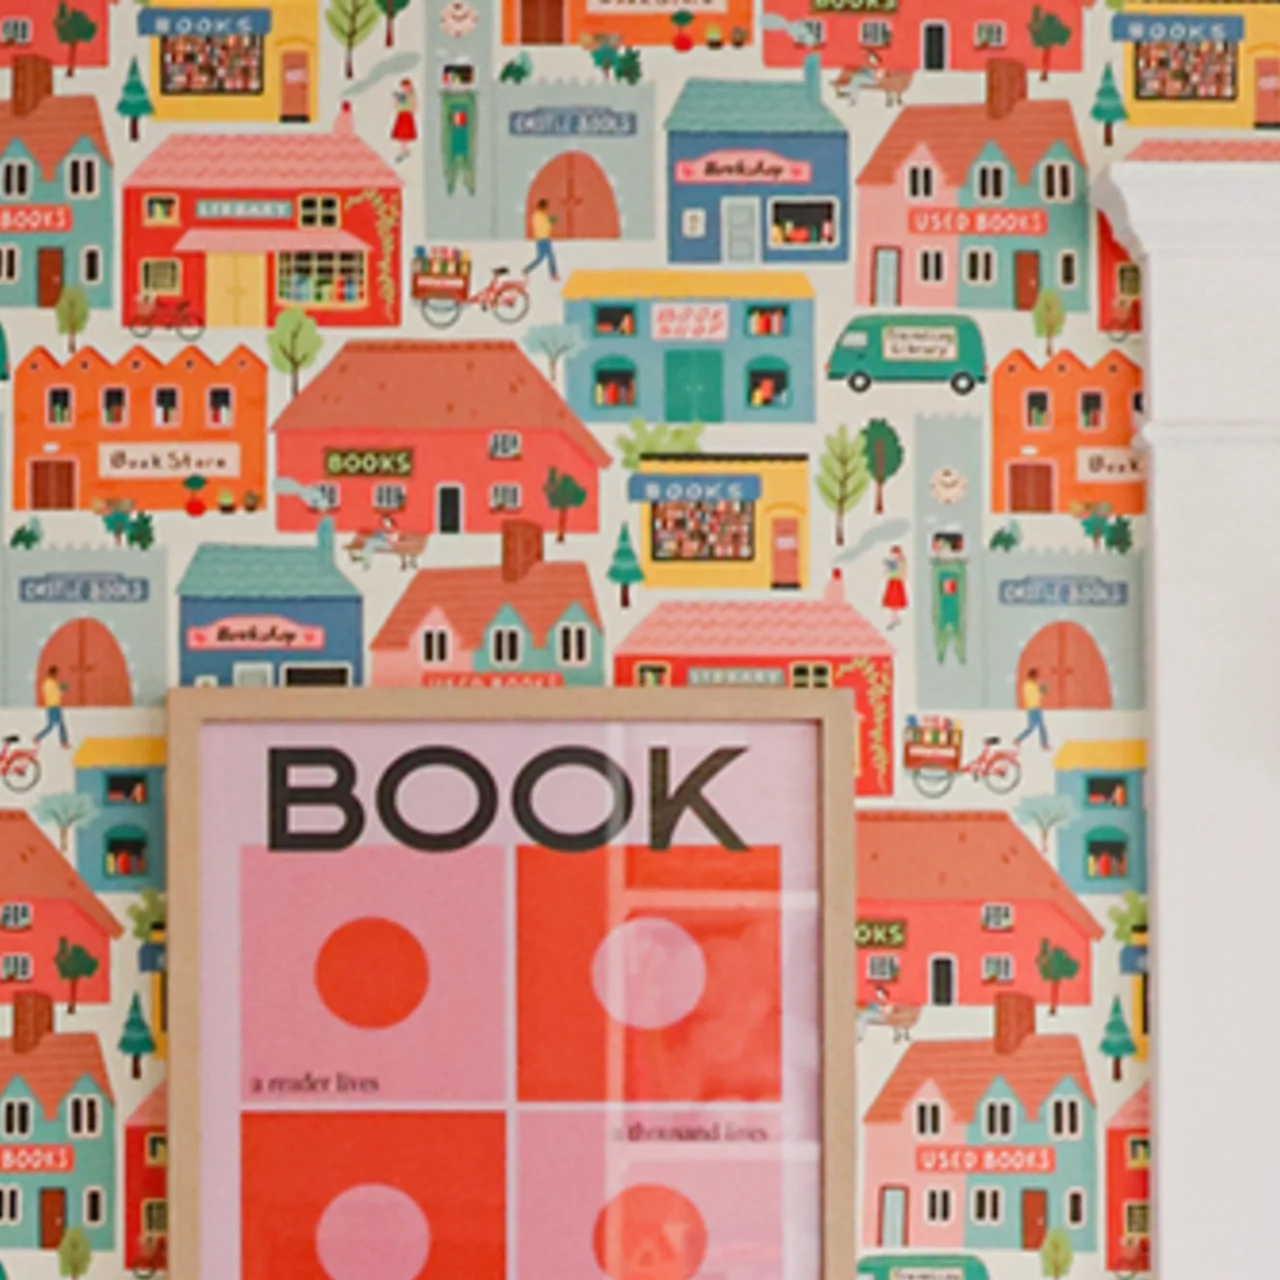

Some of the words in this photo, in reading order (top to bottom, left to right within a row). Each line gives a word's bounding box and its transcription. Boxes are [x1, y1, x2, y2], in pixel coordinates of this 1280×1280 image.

[153, 17, 252, 34] BOOKS
[1127, 23, 1226, 40] BOOKS
[0, 206, 67, 229] BOOKS
[200, 201, 287, 217] LIBRARY
[912, 210, 971, 233] USED
[975, 209, 1043, 232] BOOKS
[109, 451, 162, 470] Book
[166, 452, 228, 470] Store
[328, 453, 411, 471] BOOKS
[643, 483, 742, 500] BOOKS
[267, 745, 750, 854] BOOK
[268, 1070, 332, 1093] reader
[336, 1070, 380, 1093] lives
[0, 1146, 68, 1169] BOOKS
[920, 1148, 979, 1171] USED
[983, 1147, 1051, 1170] BOOKS
